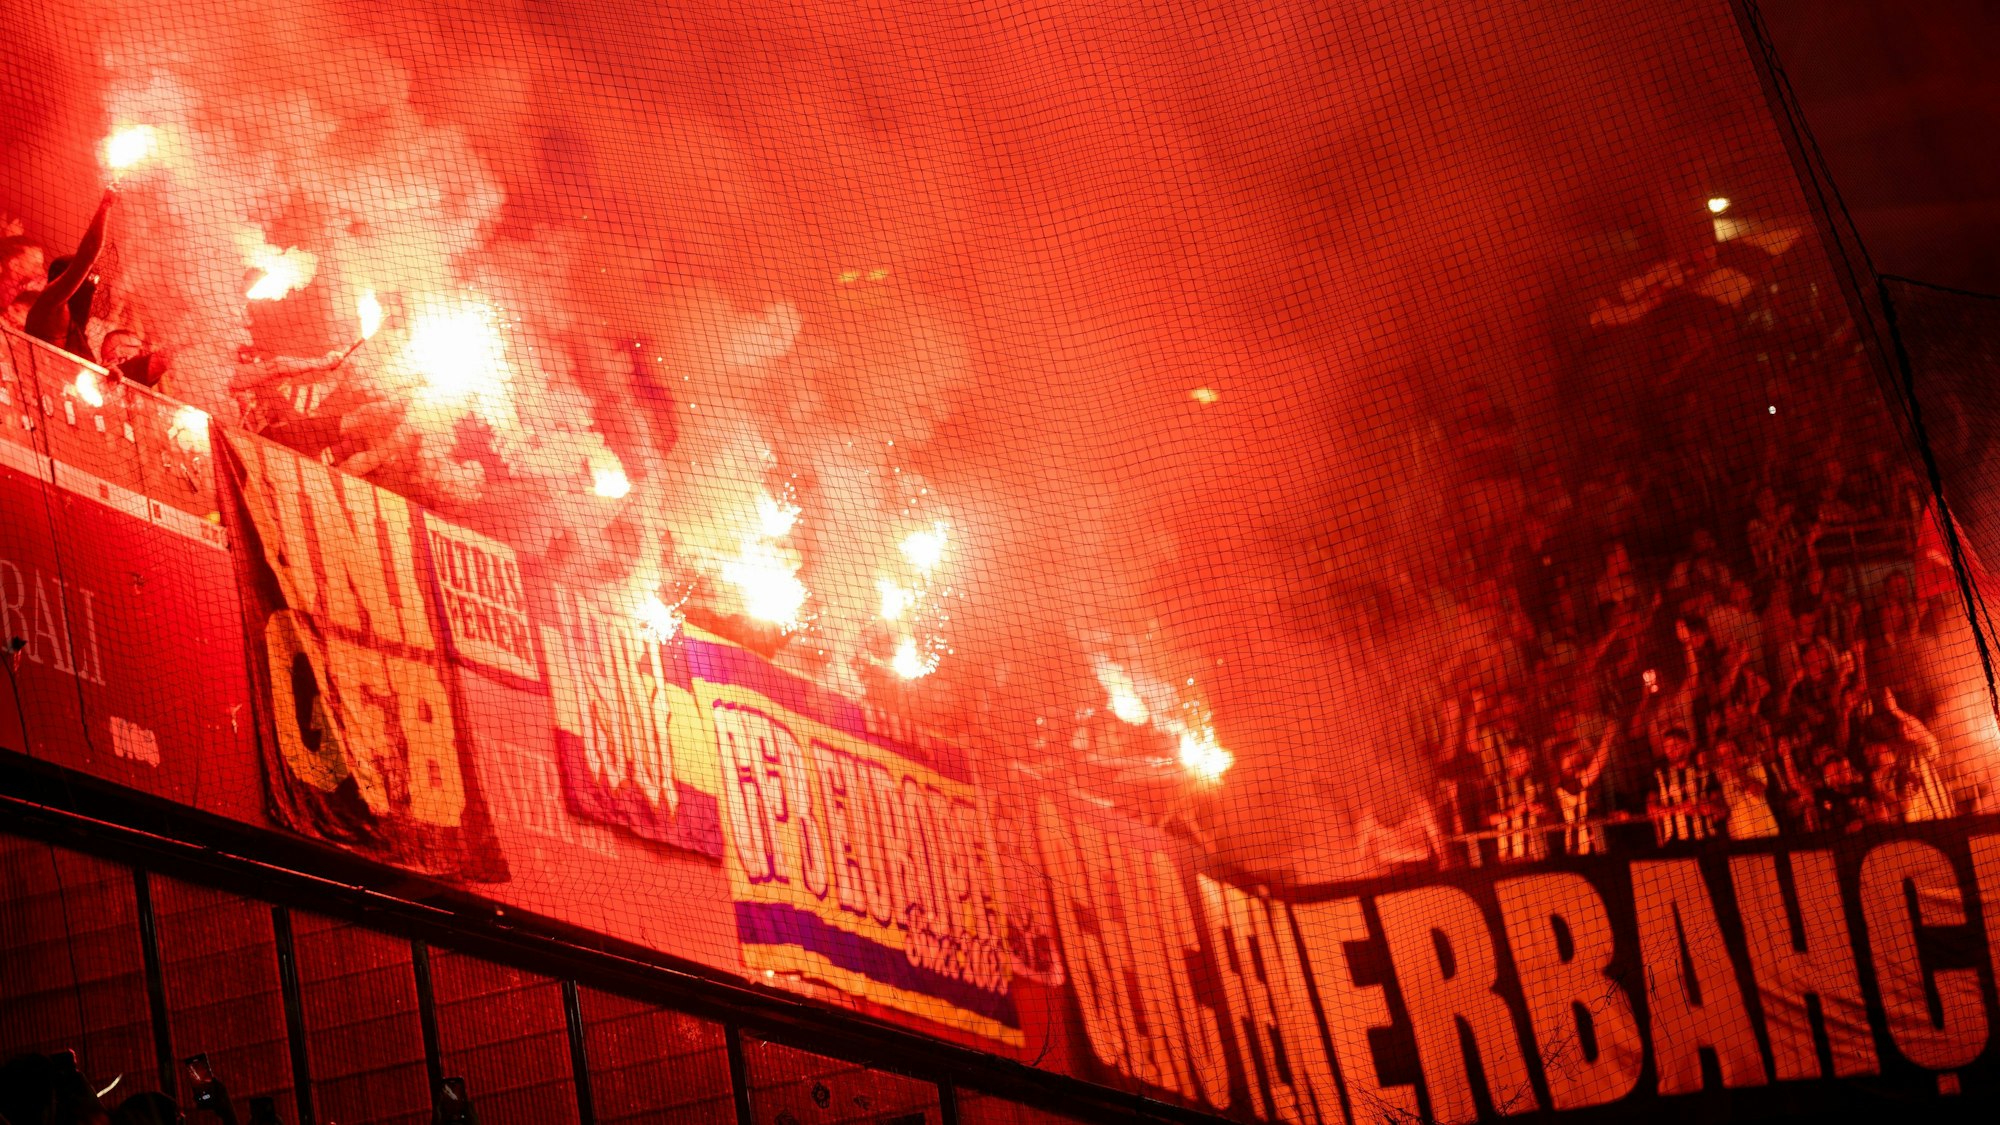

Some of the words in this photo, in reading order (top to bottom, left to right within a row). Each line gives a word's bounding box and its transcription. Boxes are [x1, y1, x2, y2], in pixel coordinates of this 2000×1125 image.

[430, 528, 526, 613] ULTRAS
[448, 587, 541, 666] FENER
[713, 698, 828, 899] GFB
[810, 739, 1004, 938] EUROPE
